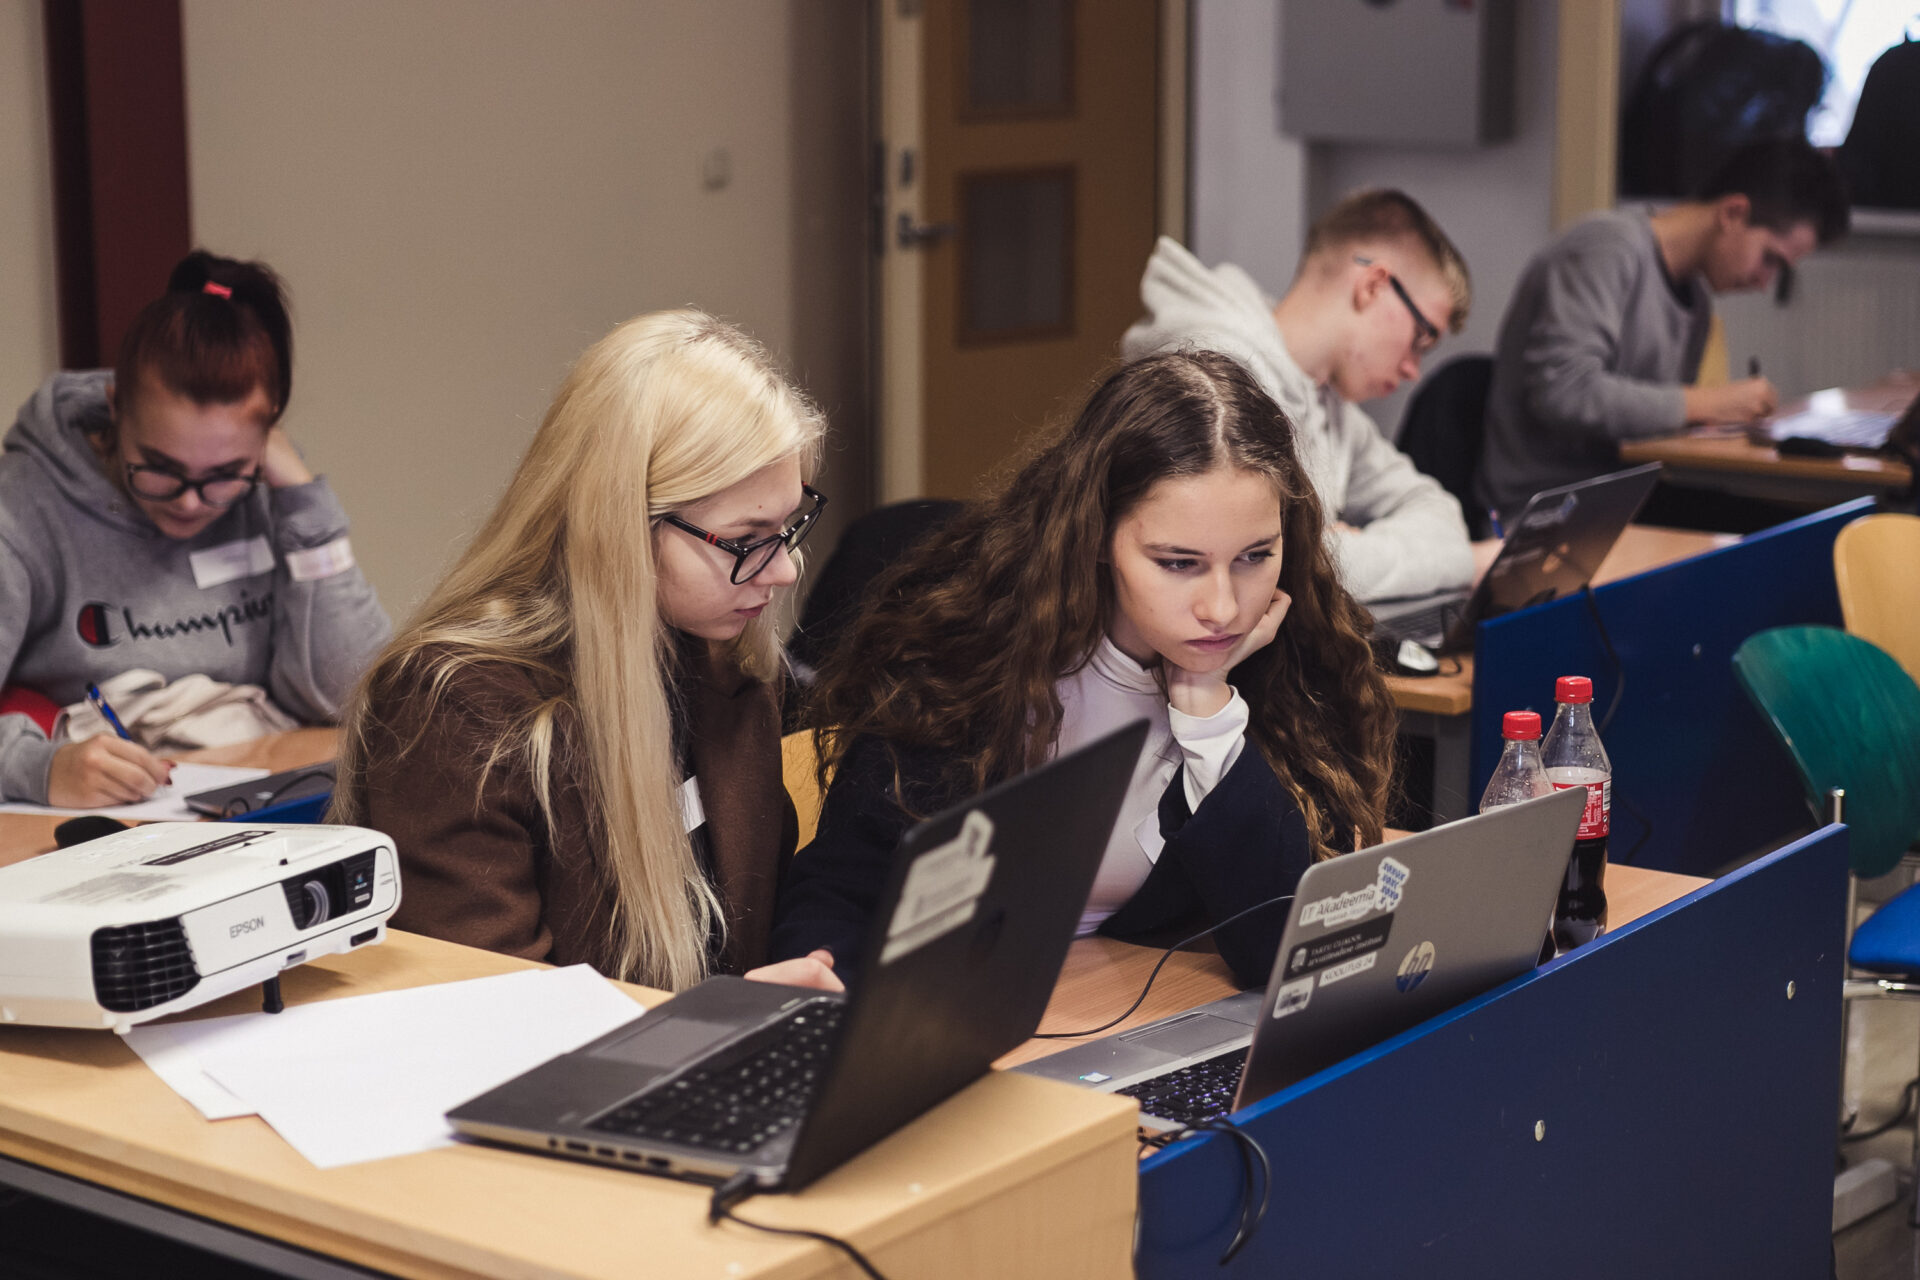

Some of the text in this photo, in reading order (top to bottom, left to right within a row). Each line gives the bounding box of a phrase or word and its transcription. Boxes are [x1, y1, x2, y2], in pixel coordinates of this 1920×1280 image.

[77, 590, 274, 649] Champio
[1302, 907, 1317, 924] IT
[1317, 889, 1375, 916] Akadeemia
[229, 916, 264, 938] EPSON
